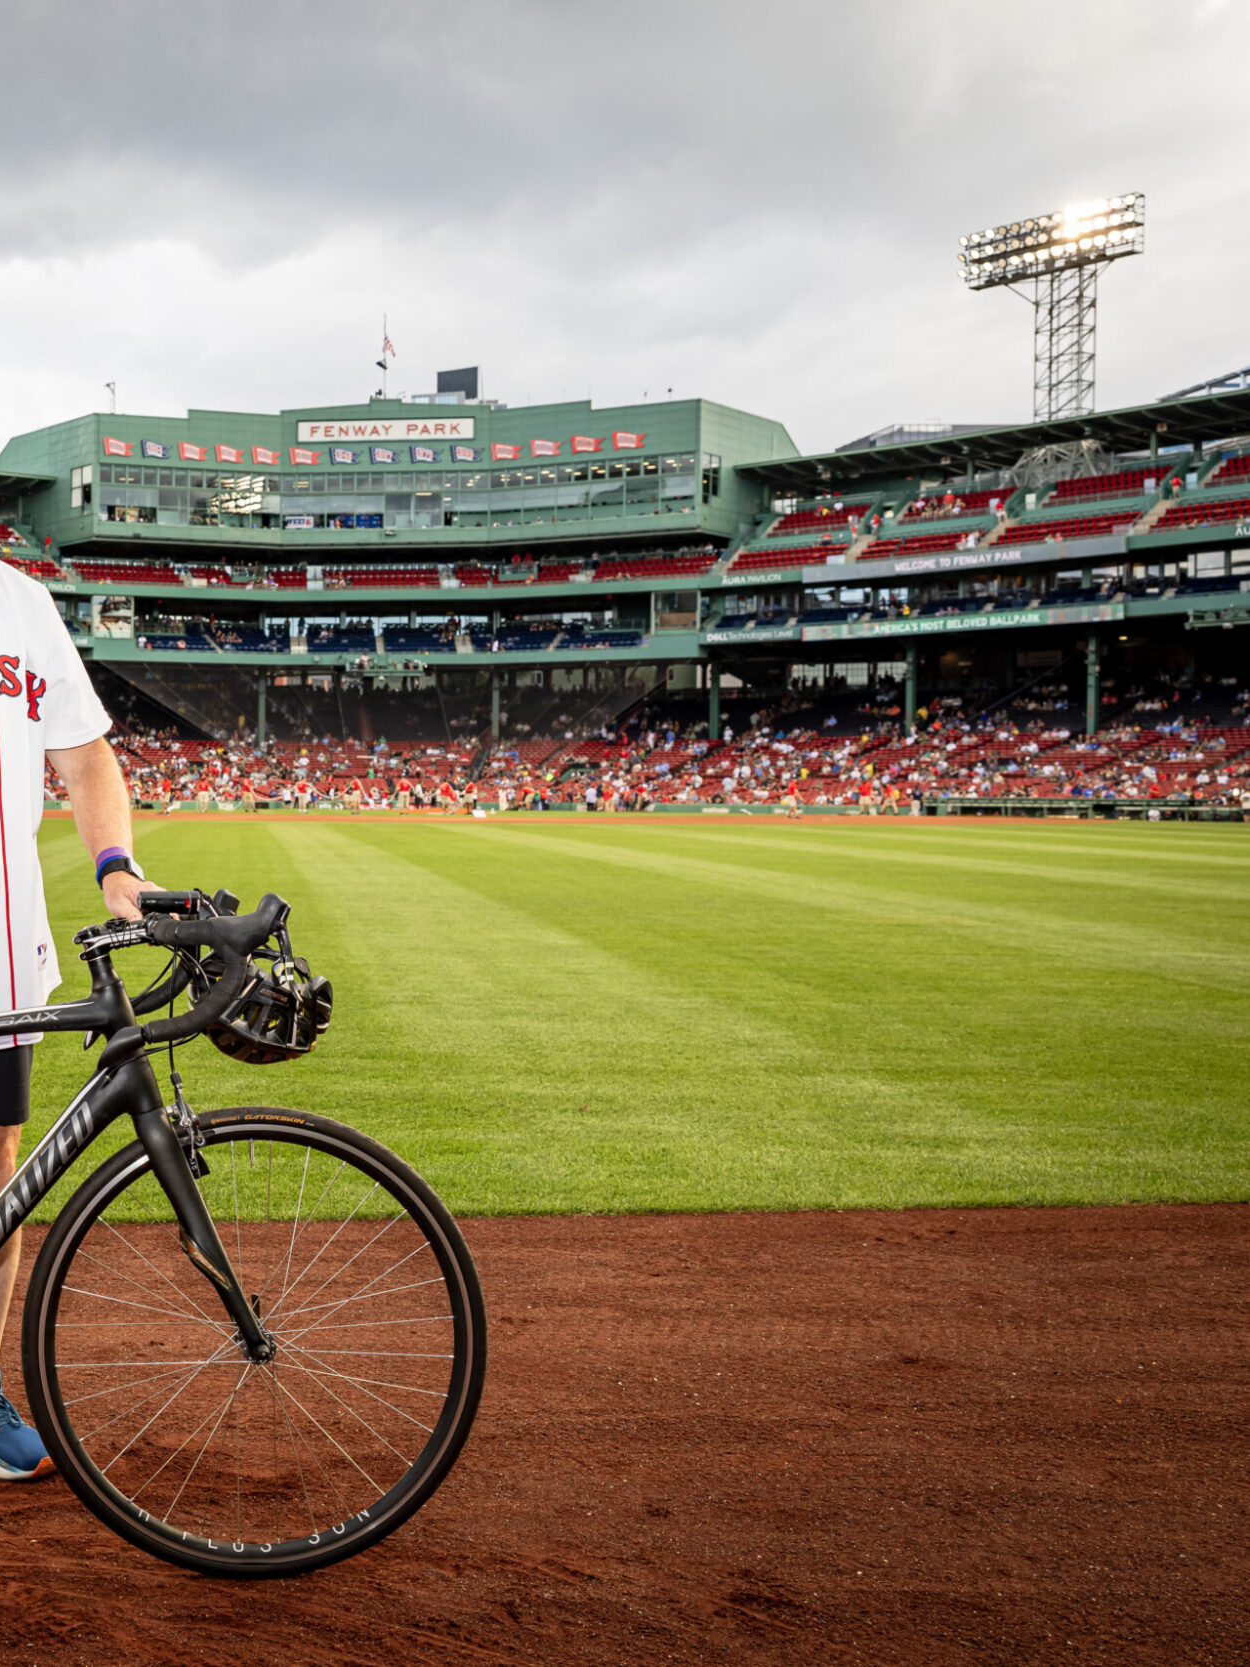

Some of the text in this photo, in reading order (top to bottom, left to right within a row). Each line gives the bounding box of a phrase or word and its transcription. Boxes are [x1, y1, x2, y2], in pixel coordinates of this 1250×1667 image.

[310, 423, 461, 438] FENWAY PARK
[894, 550, 1022, 572] WELCOME TO FENWAY PARK
[873, 614, 1040, 634] AMERICA'S MOST BELOVED BALLPARK
